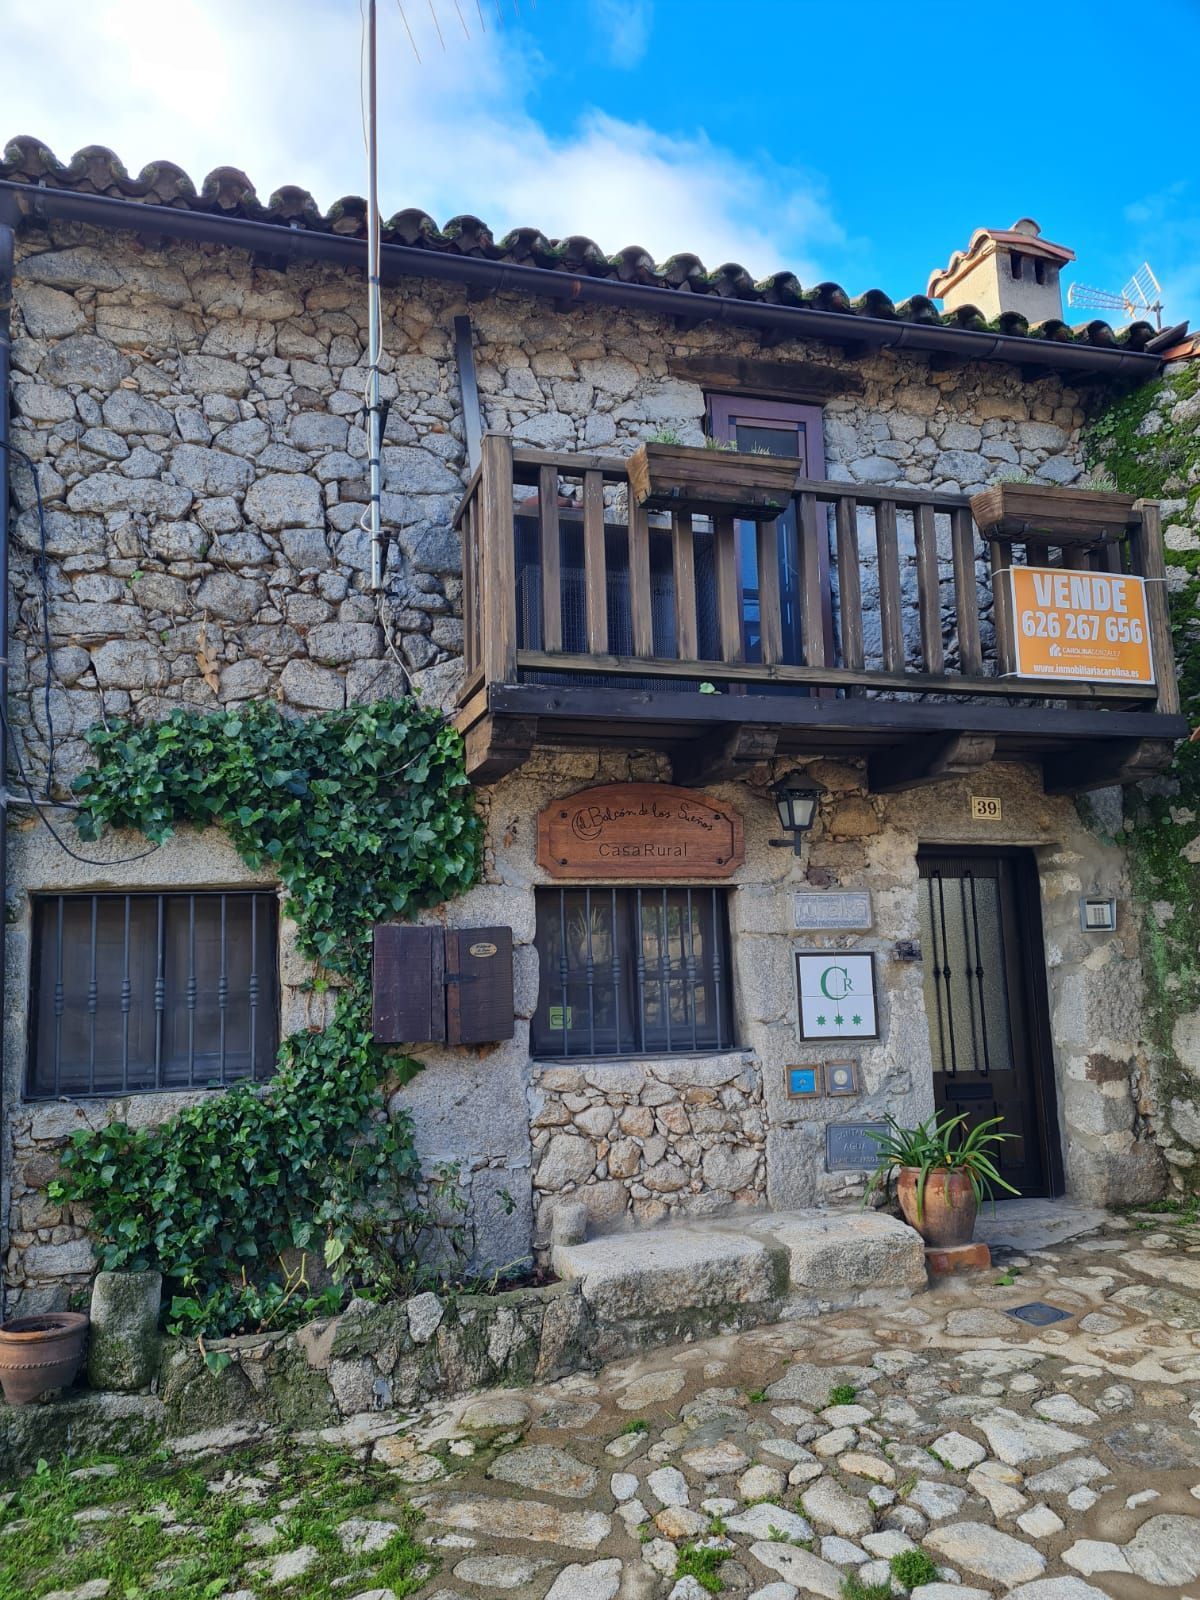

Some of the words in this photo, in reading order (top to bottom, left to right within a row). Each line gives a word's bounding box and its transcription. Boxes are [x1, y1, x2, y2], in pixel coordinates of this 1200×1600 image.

[1032, 573, 1128, 613] VENDE
[1021, 610, 1061, 638] 626
[1064, 613, 1100, 641] 267
[1105, 616, 1143, 644] 656
[1033, 664, 1139, 678] www.inmobiliariacarolina.es
[588, 806, 638, 828] Balcón
[638, 800, 648, 816] de
[652, 802, 671, 818] los
[677, 803, 713, 831] Sueños
[977, 800, 997, 815] 39
